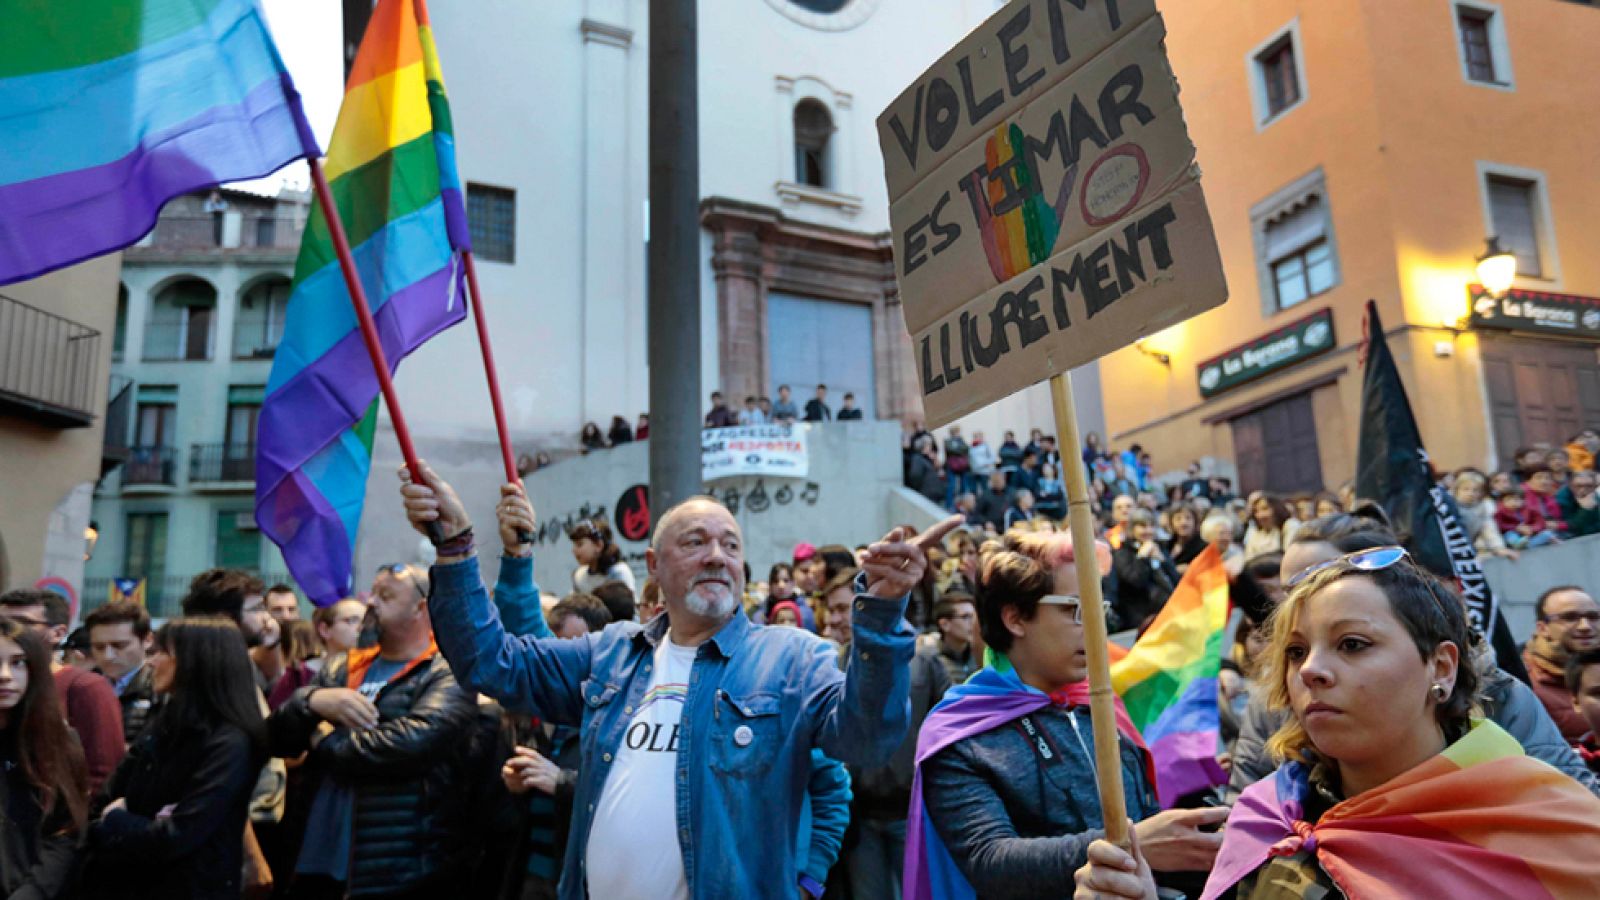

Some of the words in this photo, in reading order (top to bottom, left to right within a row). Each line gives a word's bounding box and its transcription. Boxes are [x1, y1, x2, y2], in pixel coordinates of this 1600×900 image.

[888, 0, 1122, 171] VOLEM
[921, 201, 1177, 396] LLIUREMENT
[728, 439, 802, 452] RESPOSTA
